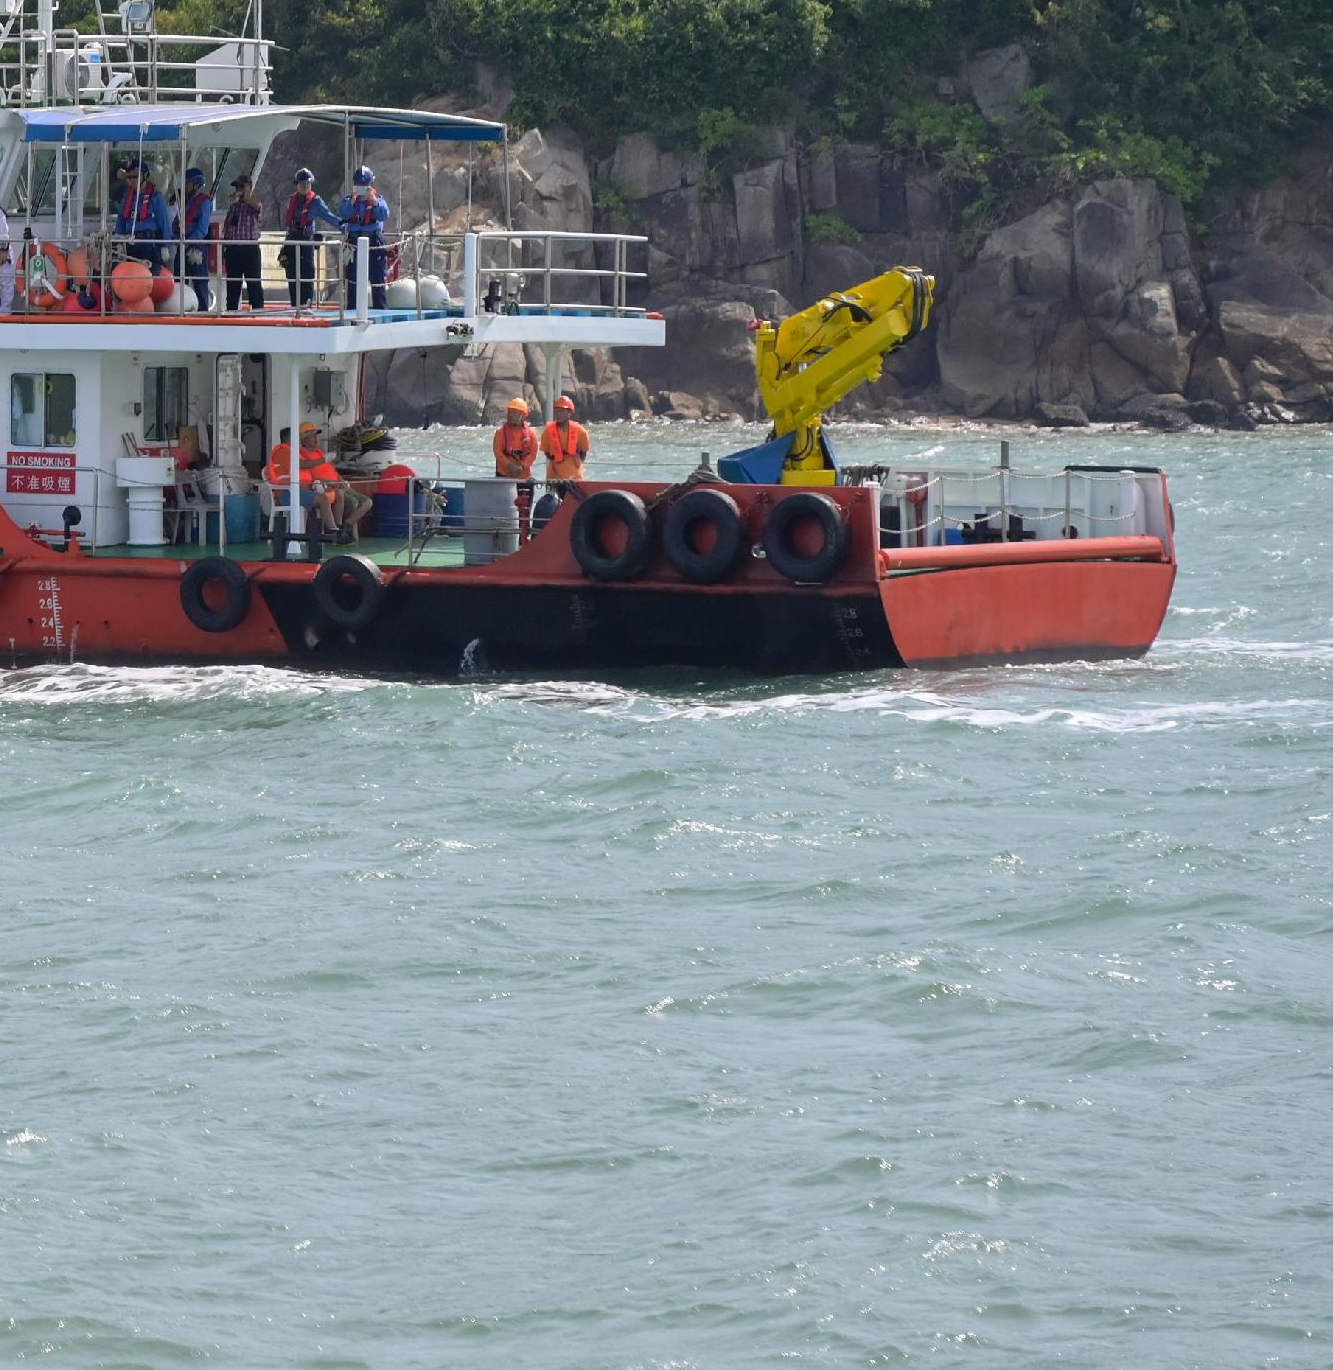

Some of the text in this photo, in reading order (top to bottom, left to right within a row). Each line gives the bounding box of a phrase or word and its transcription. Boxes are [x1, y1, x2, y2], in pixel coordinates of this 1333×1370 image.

[11, 455, 71, 467] NO SMOKING
[11, 474, 71, 492] 不准吸煙
